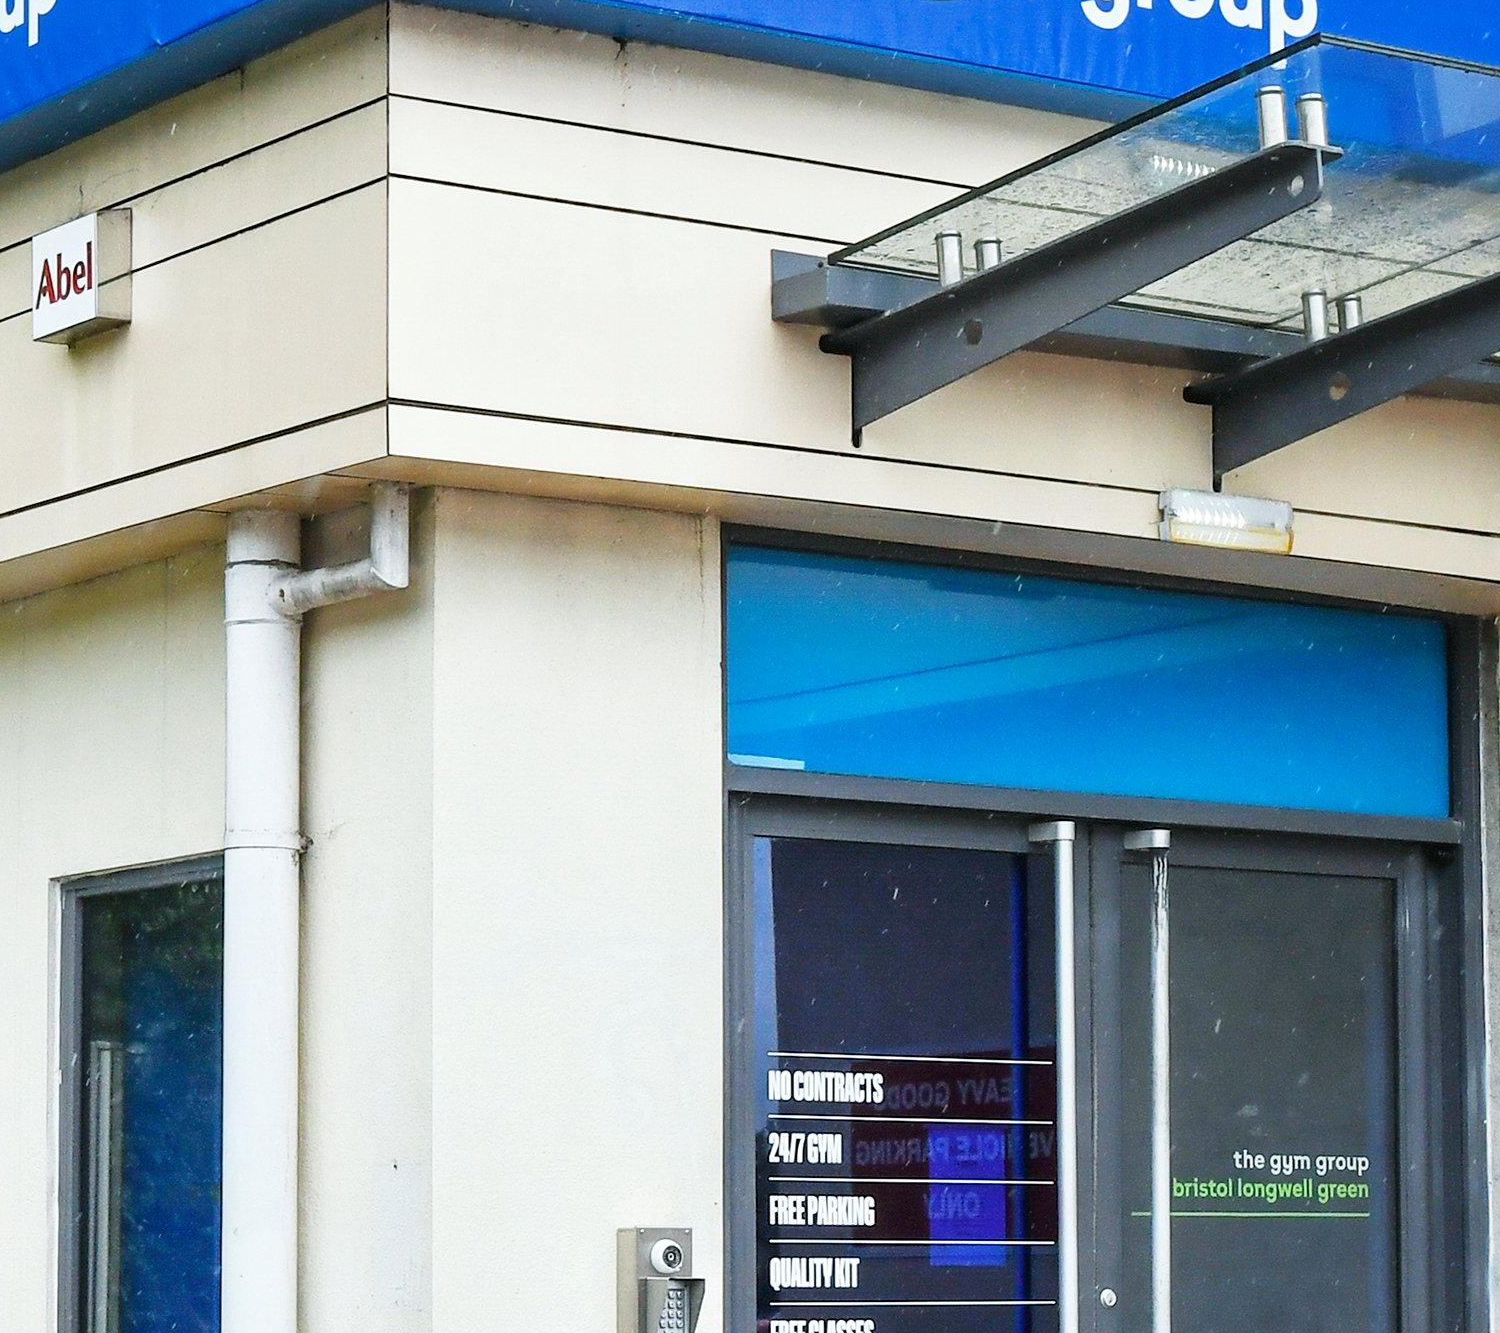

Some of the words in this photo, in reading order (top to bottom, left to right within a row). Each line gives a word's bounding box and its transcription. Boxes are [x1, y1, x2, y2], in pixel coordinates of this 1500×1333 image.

[36, 241, 93, 310] Abel
[767, 1070, 792, 1102] NO
[793, 1071, 884, 1104] CONTRACTS
[768, 1132, 807, 1164] 24/7
[807, 1133, 843, 1164] GYM
[1233, 1149, 1265, 1169] the
[1270, 1154, 1311, 1175] gym
[1315, 1155, 1370, 1176] group
[1172, 1177, 1232, 1198] bristol
[1238, 1178, 1313, 1204] longwell
[1317, 1182, 1369, 1204] green
[769, 1195, 806, 1226] FREE
[807, 1196, 876, 1226] PARKING
[769, 1257, 834, 1291] QUALITY
[834, 1257, 860, 1288] KIT
